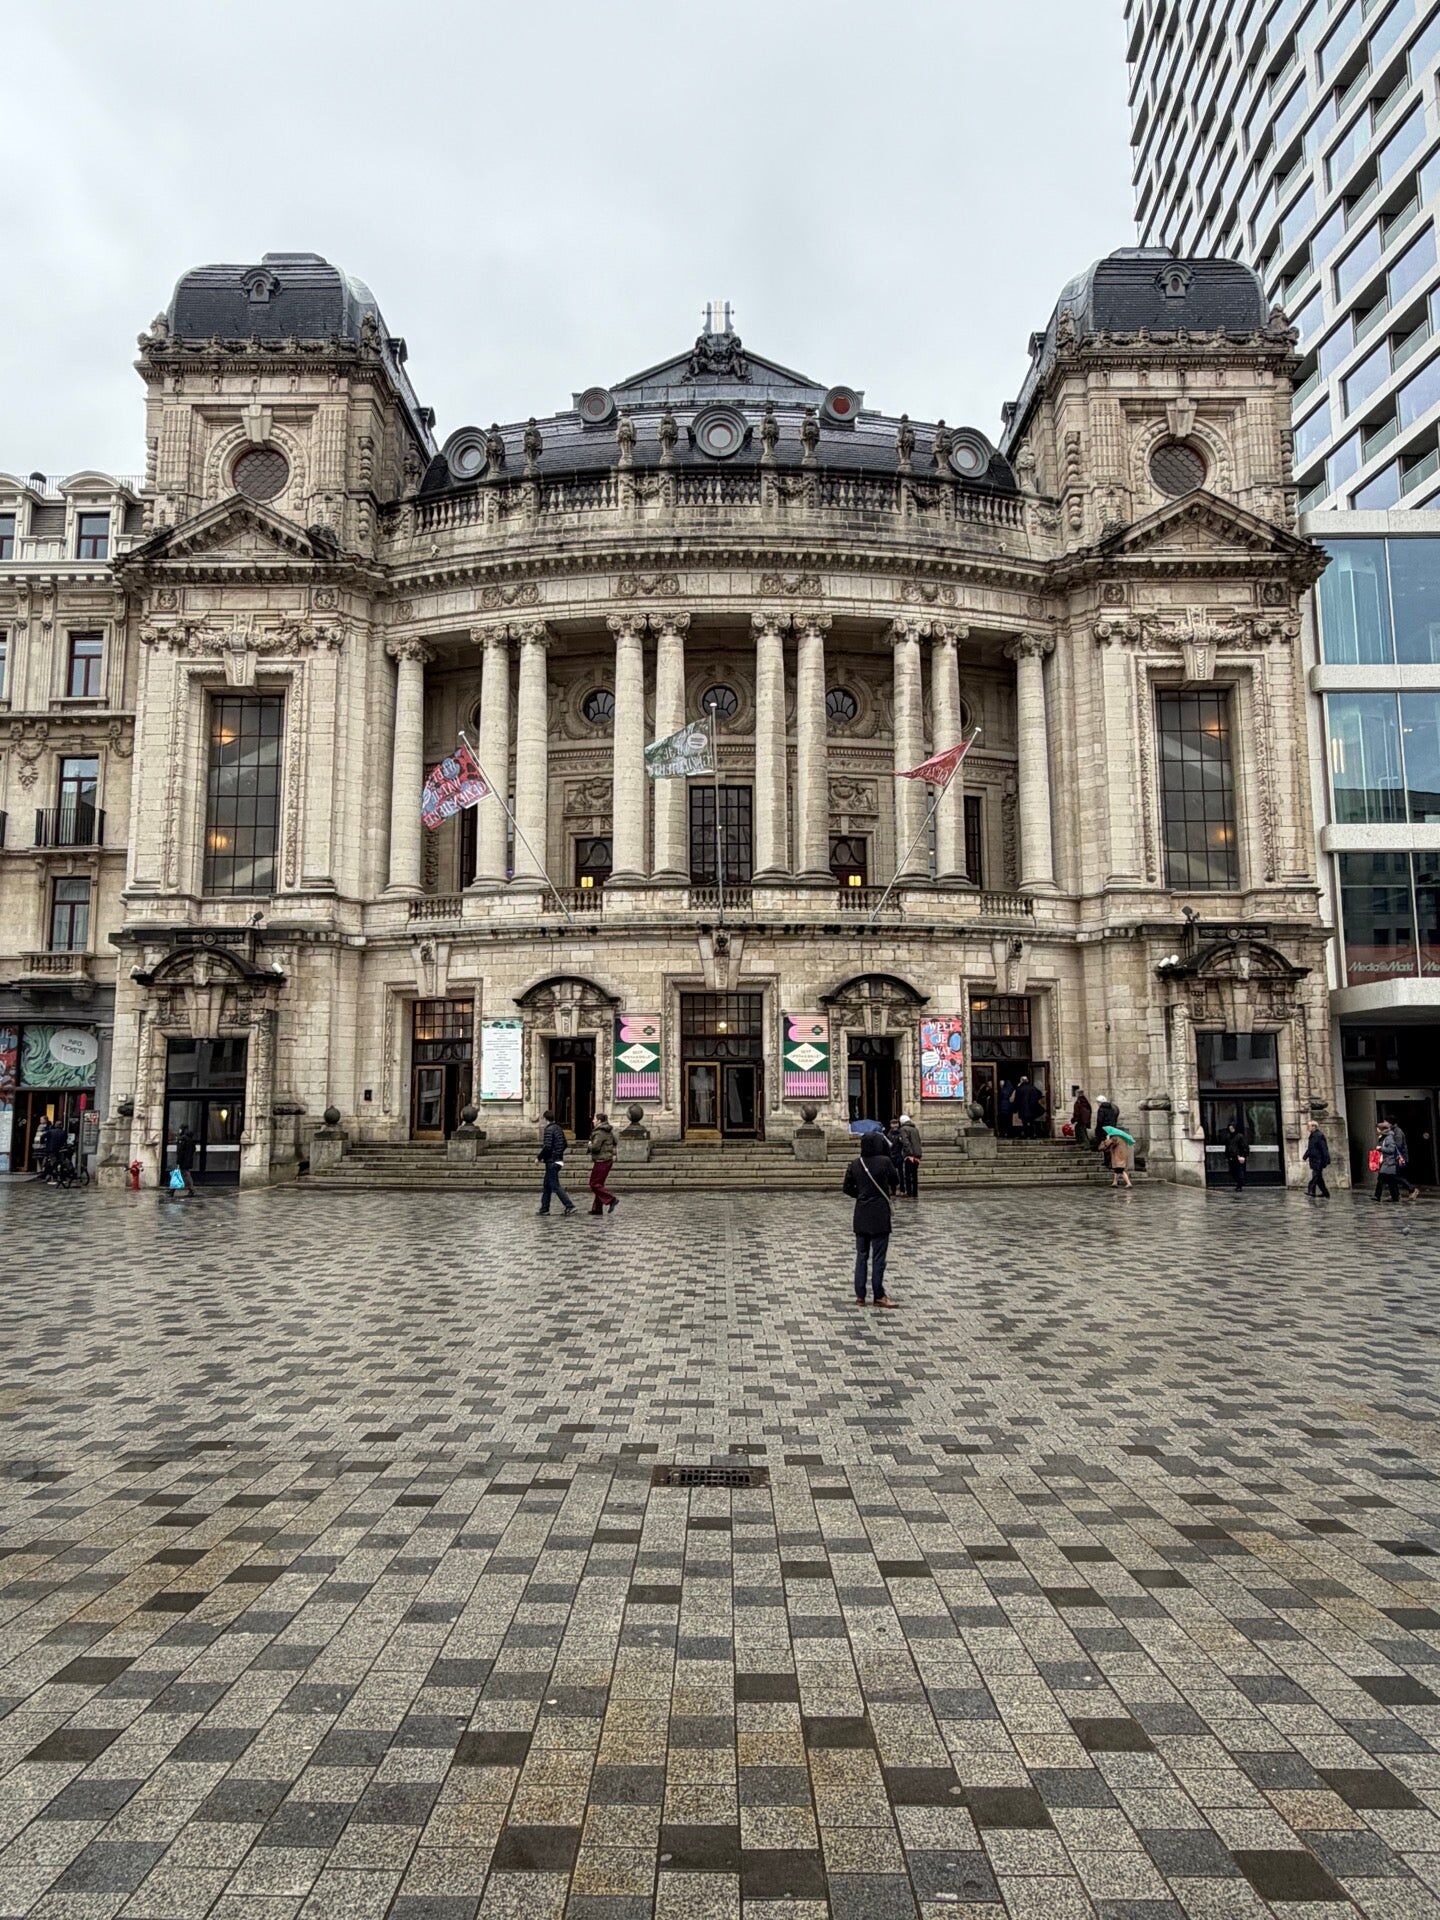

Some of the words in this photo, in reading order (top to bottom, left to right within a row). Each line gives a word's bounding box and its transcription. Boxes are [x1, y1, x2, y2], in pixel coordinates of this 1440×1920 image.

[928, 1021, 955, 1030] WEET
[936, 1033, 947, 1043] JE
[68, 1039, 83, 1047] INFO
[61, 1044, 85, 1055] TICKETS
[933, 1047, 952, 1056] WAT
[937, 1060, 949, 1069] JE
[926, 1071, 960, 1081] GEZIEN
[928, 1084, 957, 1094] HEBT?
